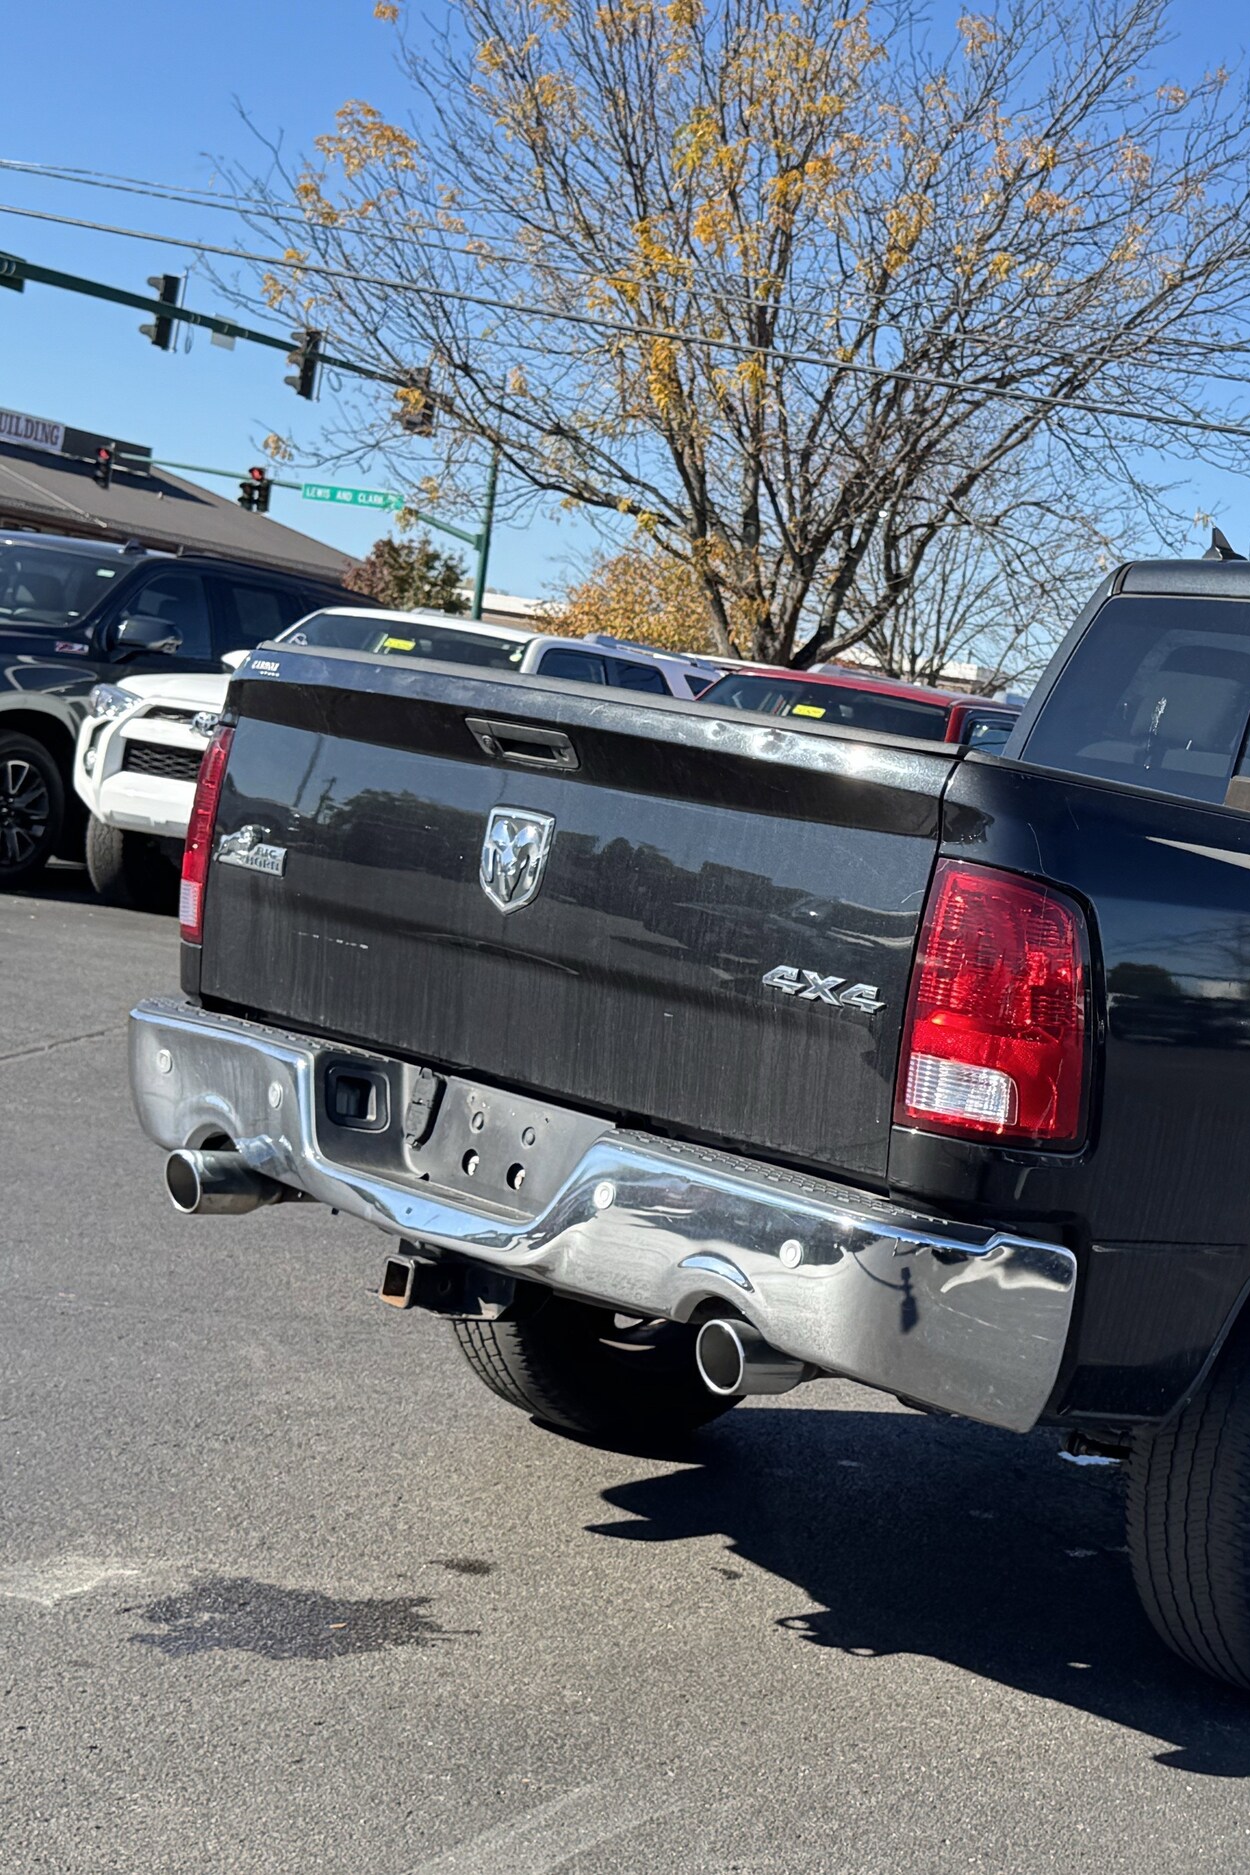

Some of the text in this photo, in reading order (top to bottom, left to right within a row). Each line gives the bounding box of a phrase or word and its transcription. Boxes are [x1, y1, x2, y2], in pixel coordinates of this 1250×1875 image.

[306, 487, 331, 499] LEWIS
[336, 490, 353, 502] AND
[256, 846, 278, 858] BIG
[245, 855, 280, 871] HORN
